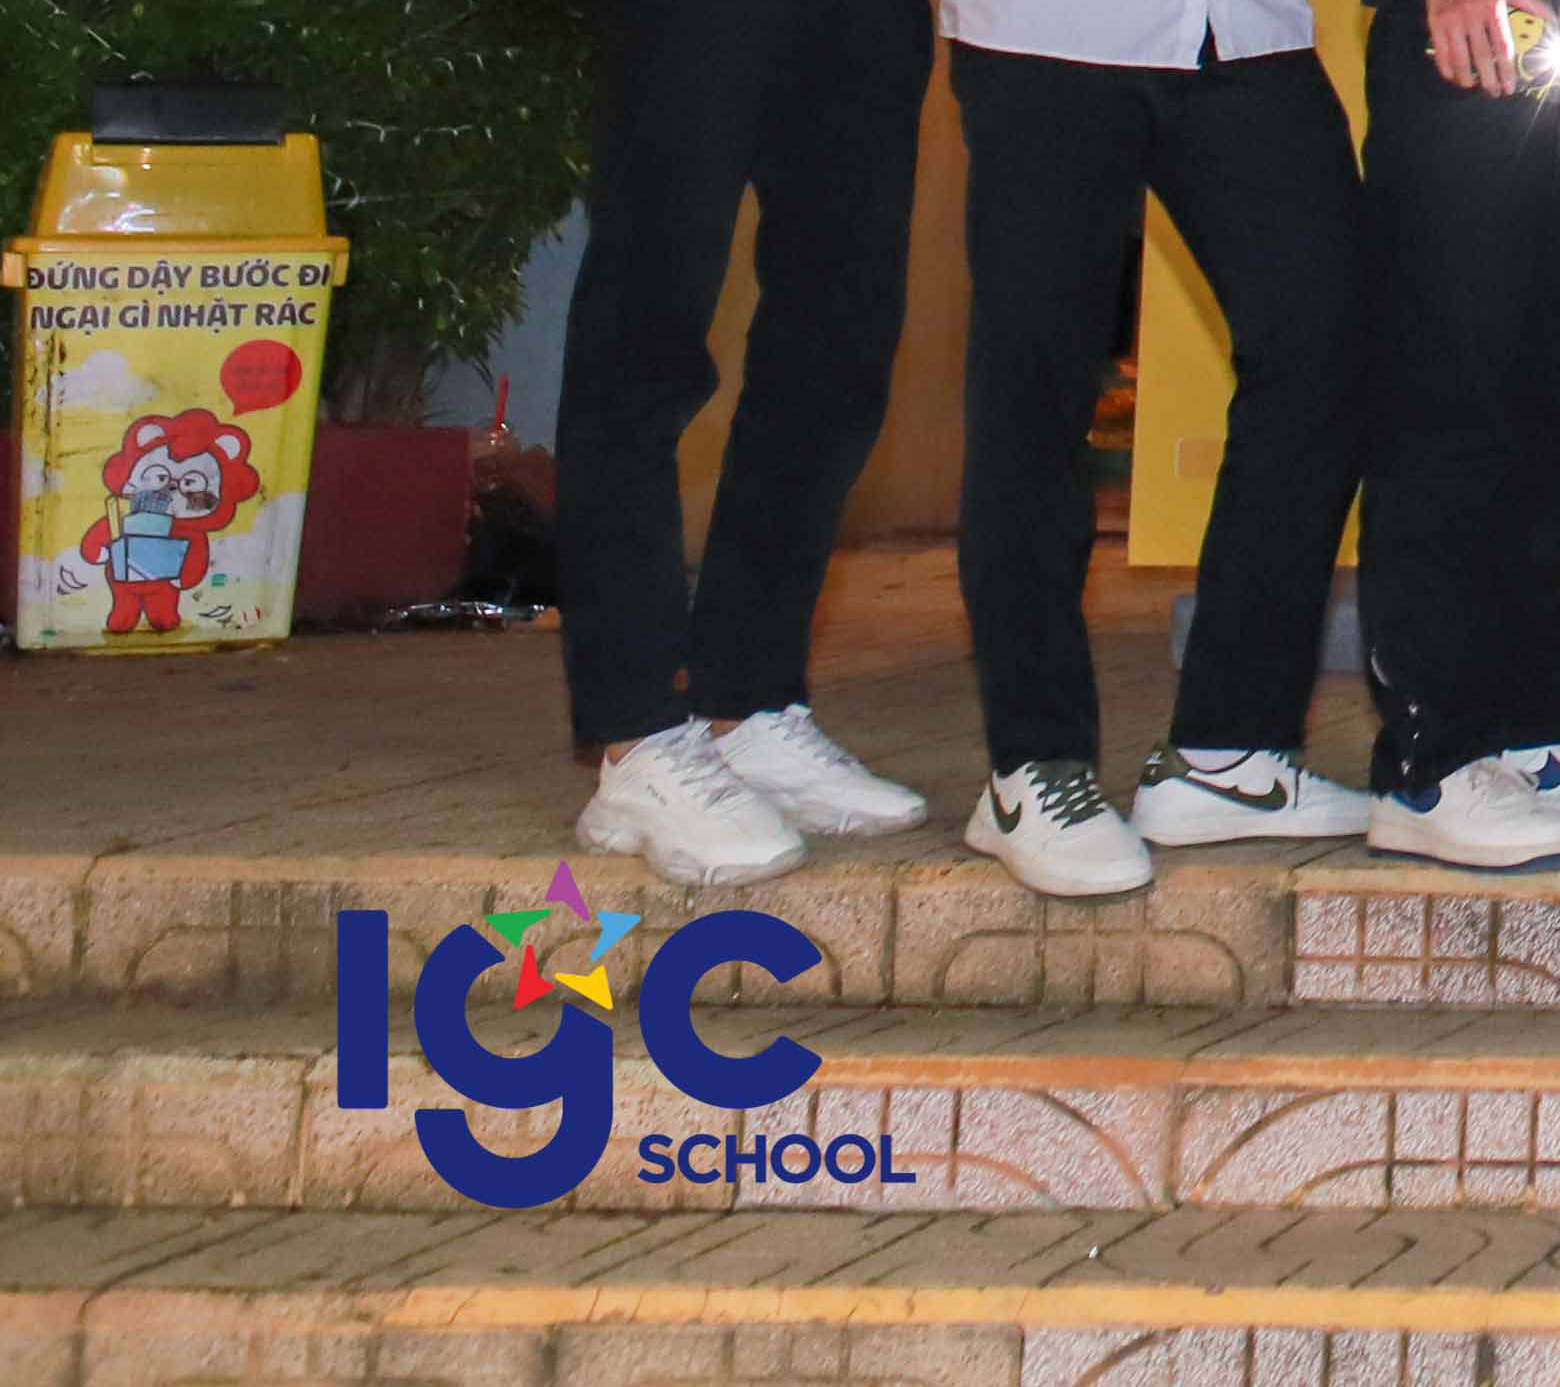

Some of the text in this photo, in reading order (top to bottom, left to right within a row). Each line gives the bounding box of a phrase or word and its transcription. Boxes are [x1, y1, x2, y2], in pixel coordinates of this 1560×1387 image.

[26, 258, 331, 295] ĐỨNG DẬY BƯỚC ĐI
[30, 295, 318, 336] NGẠI GÌ NHẶT RÁC
